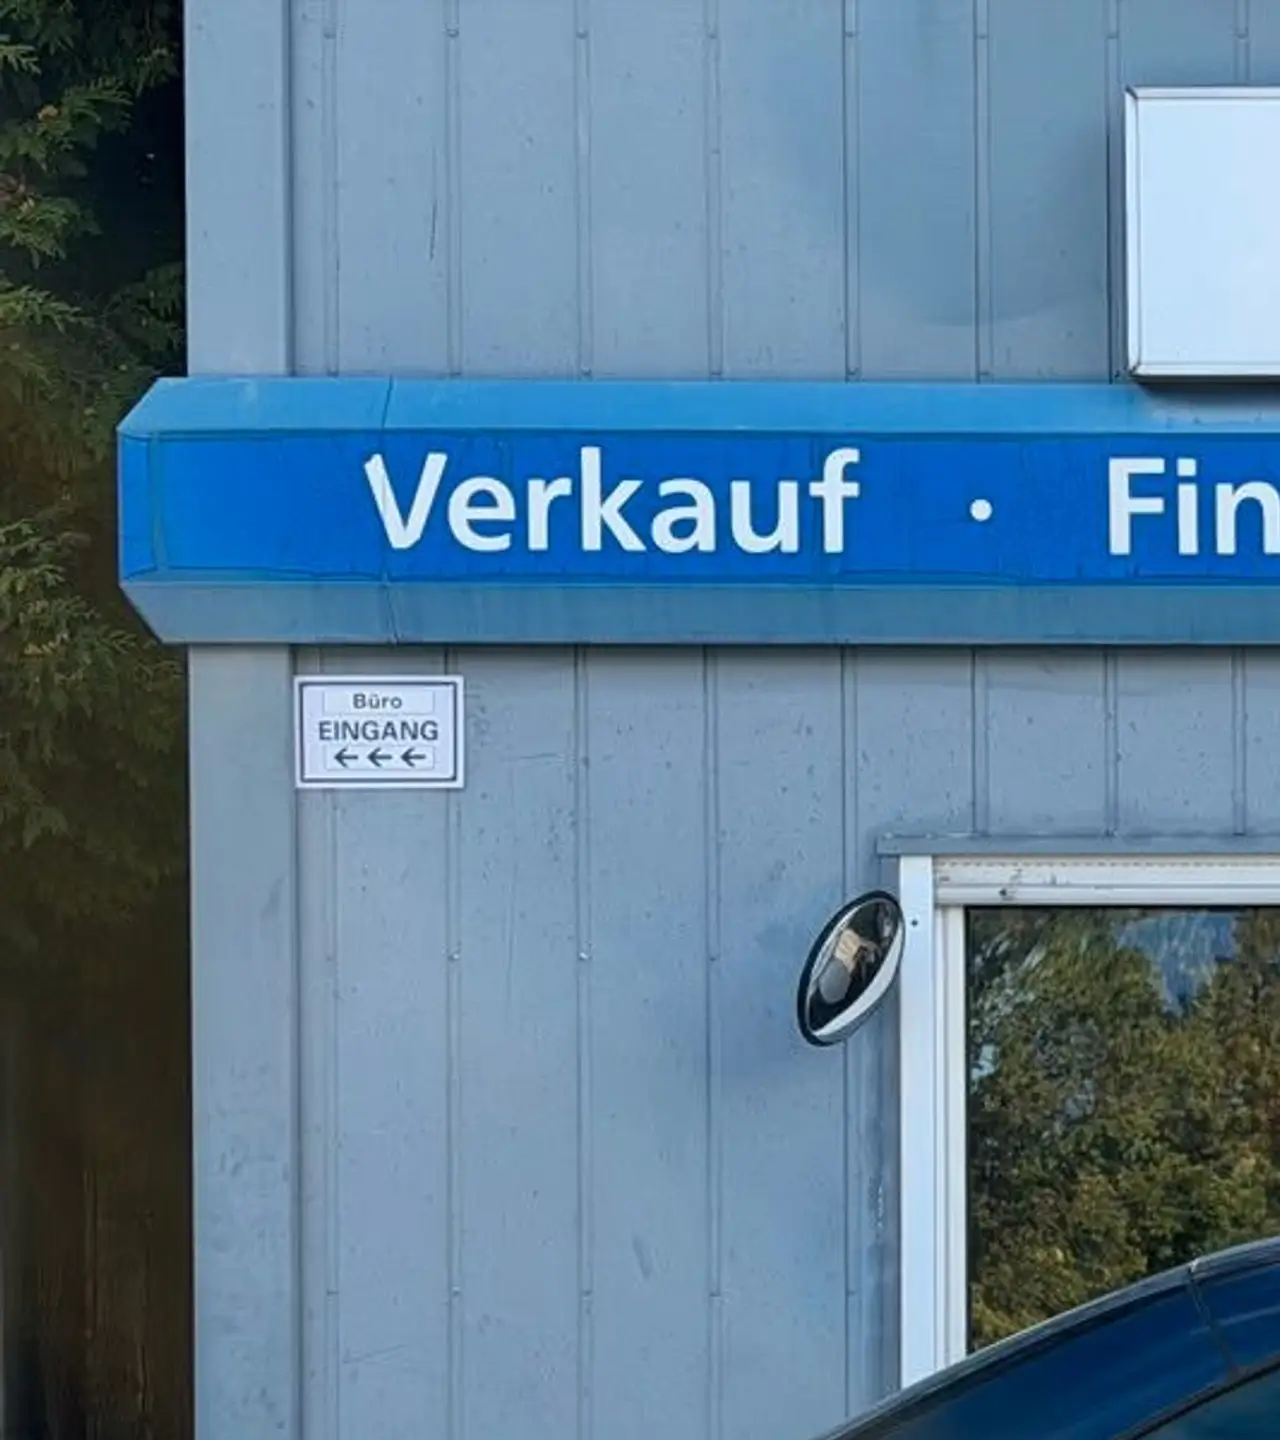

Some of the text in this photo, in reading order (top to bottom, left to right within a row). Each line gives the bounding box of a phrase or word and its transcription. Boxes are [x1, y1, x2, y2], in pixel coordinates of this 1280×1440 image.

[363, 446, 861, 553] Verkauf
[353, 693, 403, 709] Büro
[318, 720, 439, 741] EINGANG
